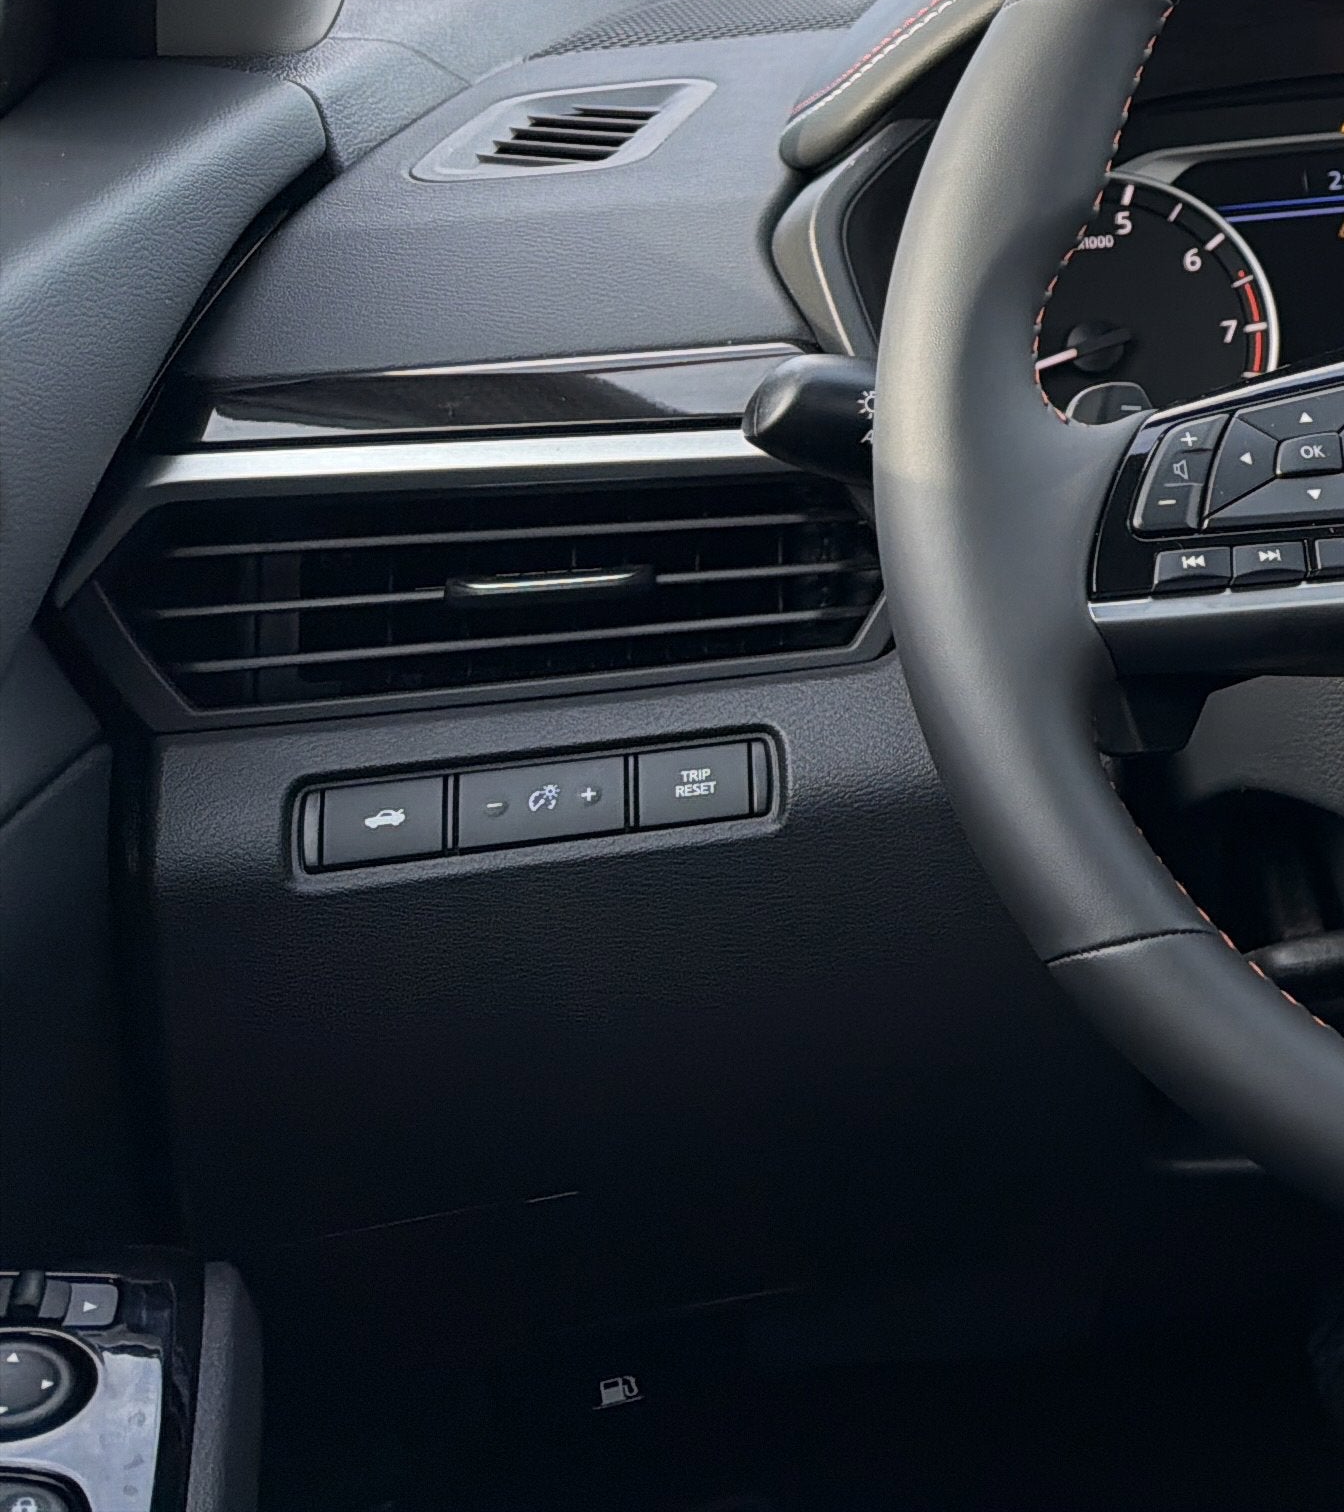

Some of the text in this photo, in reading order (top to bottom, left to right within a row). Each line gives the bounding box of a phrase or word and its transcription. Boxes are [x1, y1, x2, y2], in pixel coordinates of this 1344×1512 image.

[1114, 210, 1133, 236] 5
[1183, 247, 1202, 272] 6
[1219, 319, 1238, 343] 7
[1300, 445, 1326, 459] OK
[681, 768, 711, 782] TRIP
[675, 781, 716, 797] RESET
